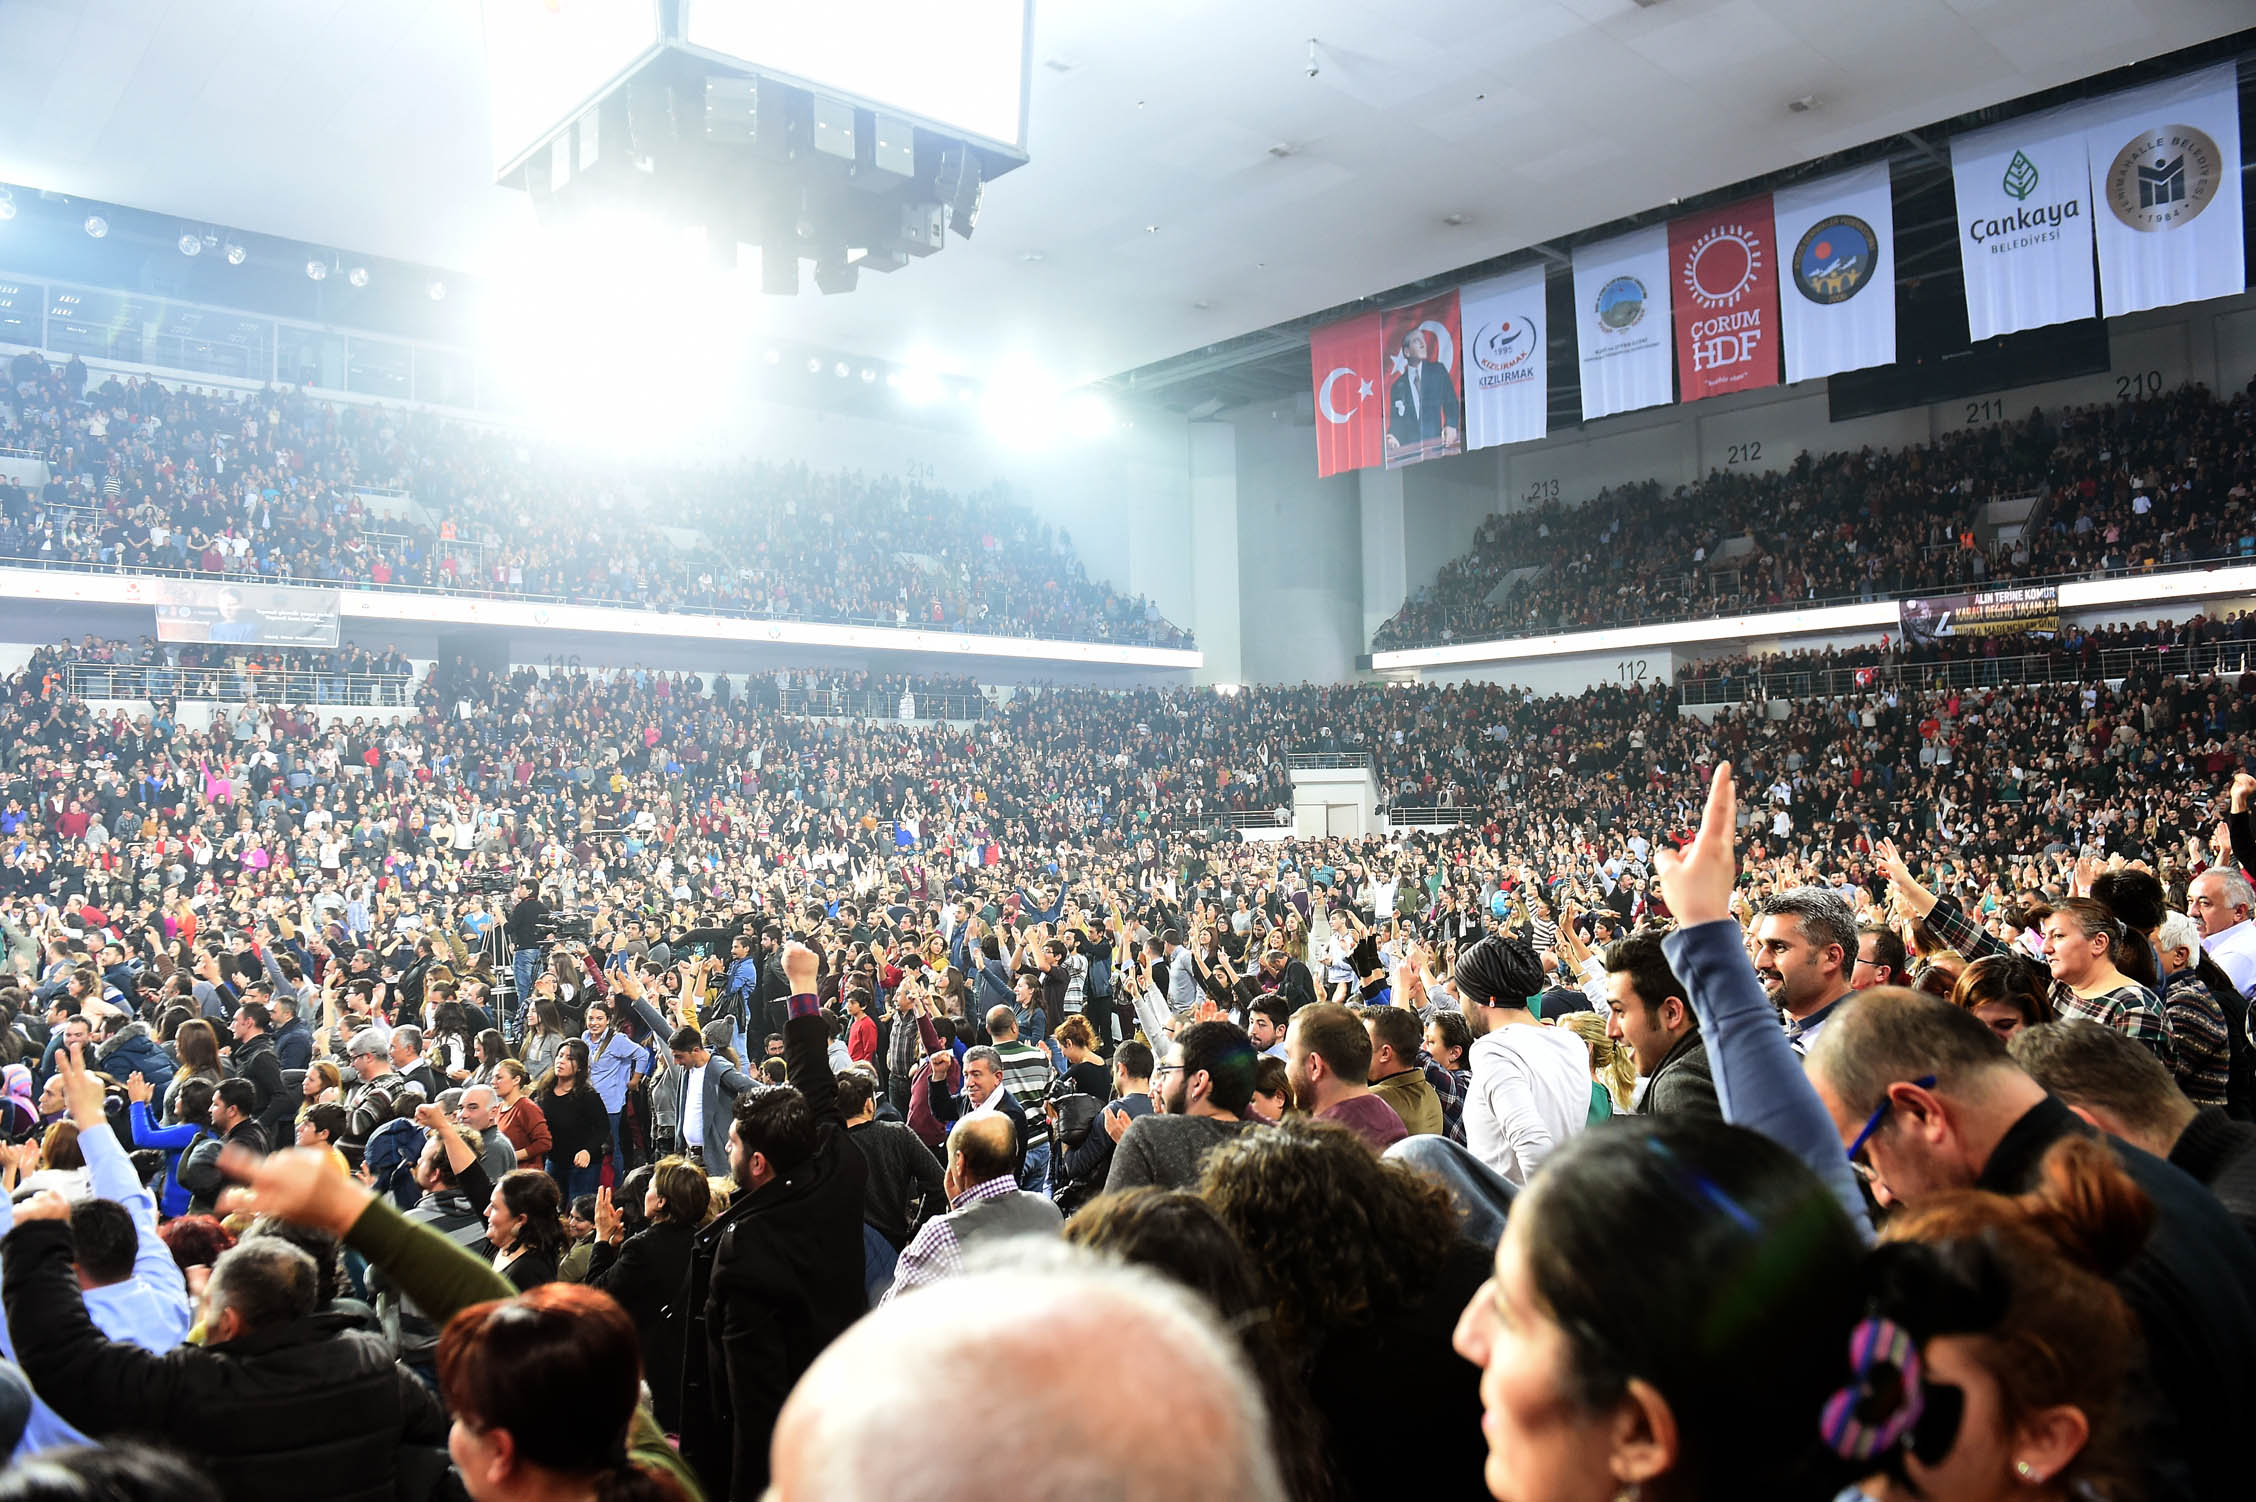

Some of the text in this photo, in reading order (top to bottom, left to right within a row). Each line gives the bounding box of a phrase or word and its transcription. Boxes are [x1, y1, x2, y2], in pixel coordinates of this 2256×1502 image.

[1970, 199, 2080, 244] Çankaya
[2147, 209, 2180, 223] 1984
[1691, 308, 1761, 341] ÇORUM
[1494, 346, 1513, 356] 1995
[1692, 329, 1761, 372] HDF
[1479, 366, 1534, 387] KIZILIRMAK
[2116, 370, 2164, 399] 210
[1966, 398, 2004, 424] 211
[1728, 441, 1763, 465] 212
[1531, 479, 1561, 500] 213
[1617, 660, 1648, 681] 112
